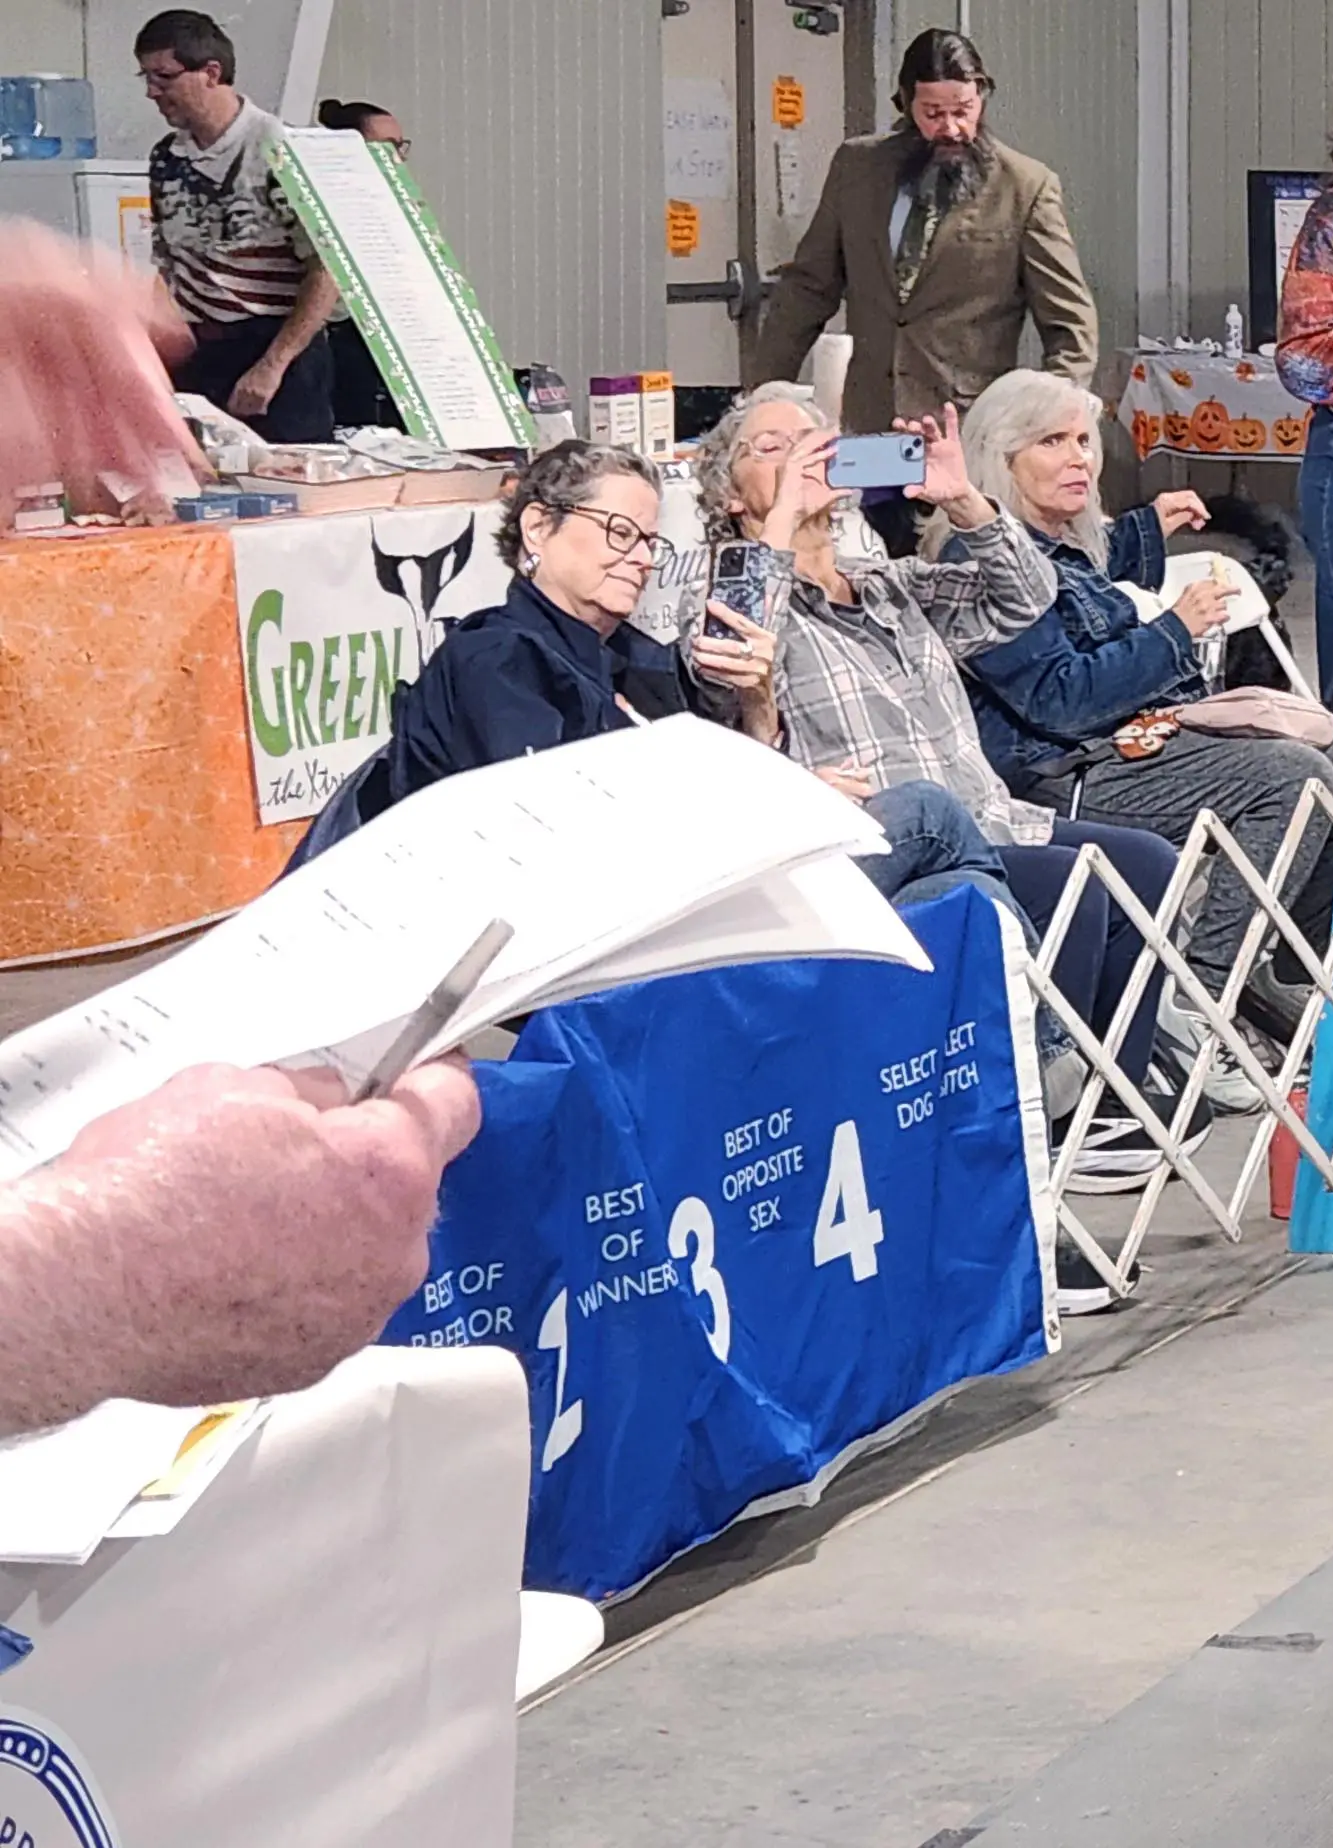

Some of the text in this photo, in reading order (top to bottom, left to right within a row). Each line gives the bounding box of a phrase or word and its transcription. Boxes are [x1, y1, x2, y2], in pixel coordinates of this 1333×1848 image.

[246, 589, 404, 758] GREEN
[304, 758, 346, 806] Xtr
[944, 1020, 977, 1058] LECT
[880, 1048, 939, 1094] SELECT
[938, 1060, 981, 1099] ITCH
[897, 1090, 934, 1130] DOG
[723, 1107, 794, 1159] BEST OF
[722, 1144, 805, 1202] OPPOSITE
[585, 1182, 645, 1224] BEST
[748, 1195, 783, 1233] SEX
[813, 1119, 884, 1283] 4
[601, 1228, 645, 1262] OF
[459, 1262, 505, 1295] OF
[667, 1195, 731, 1365] 3
[468, 1305, 515, 1339] OR
